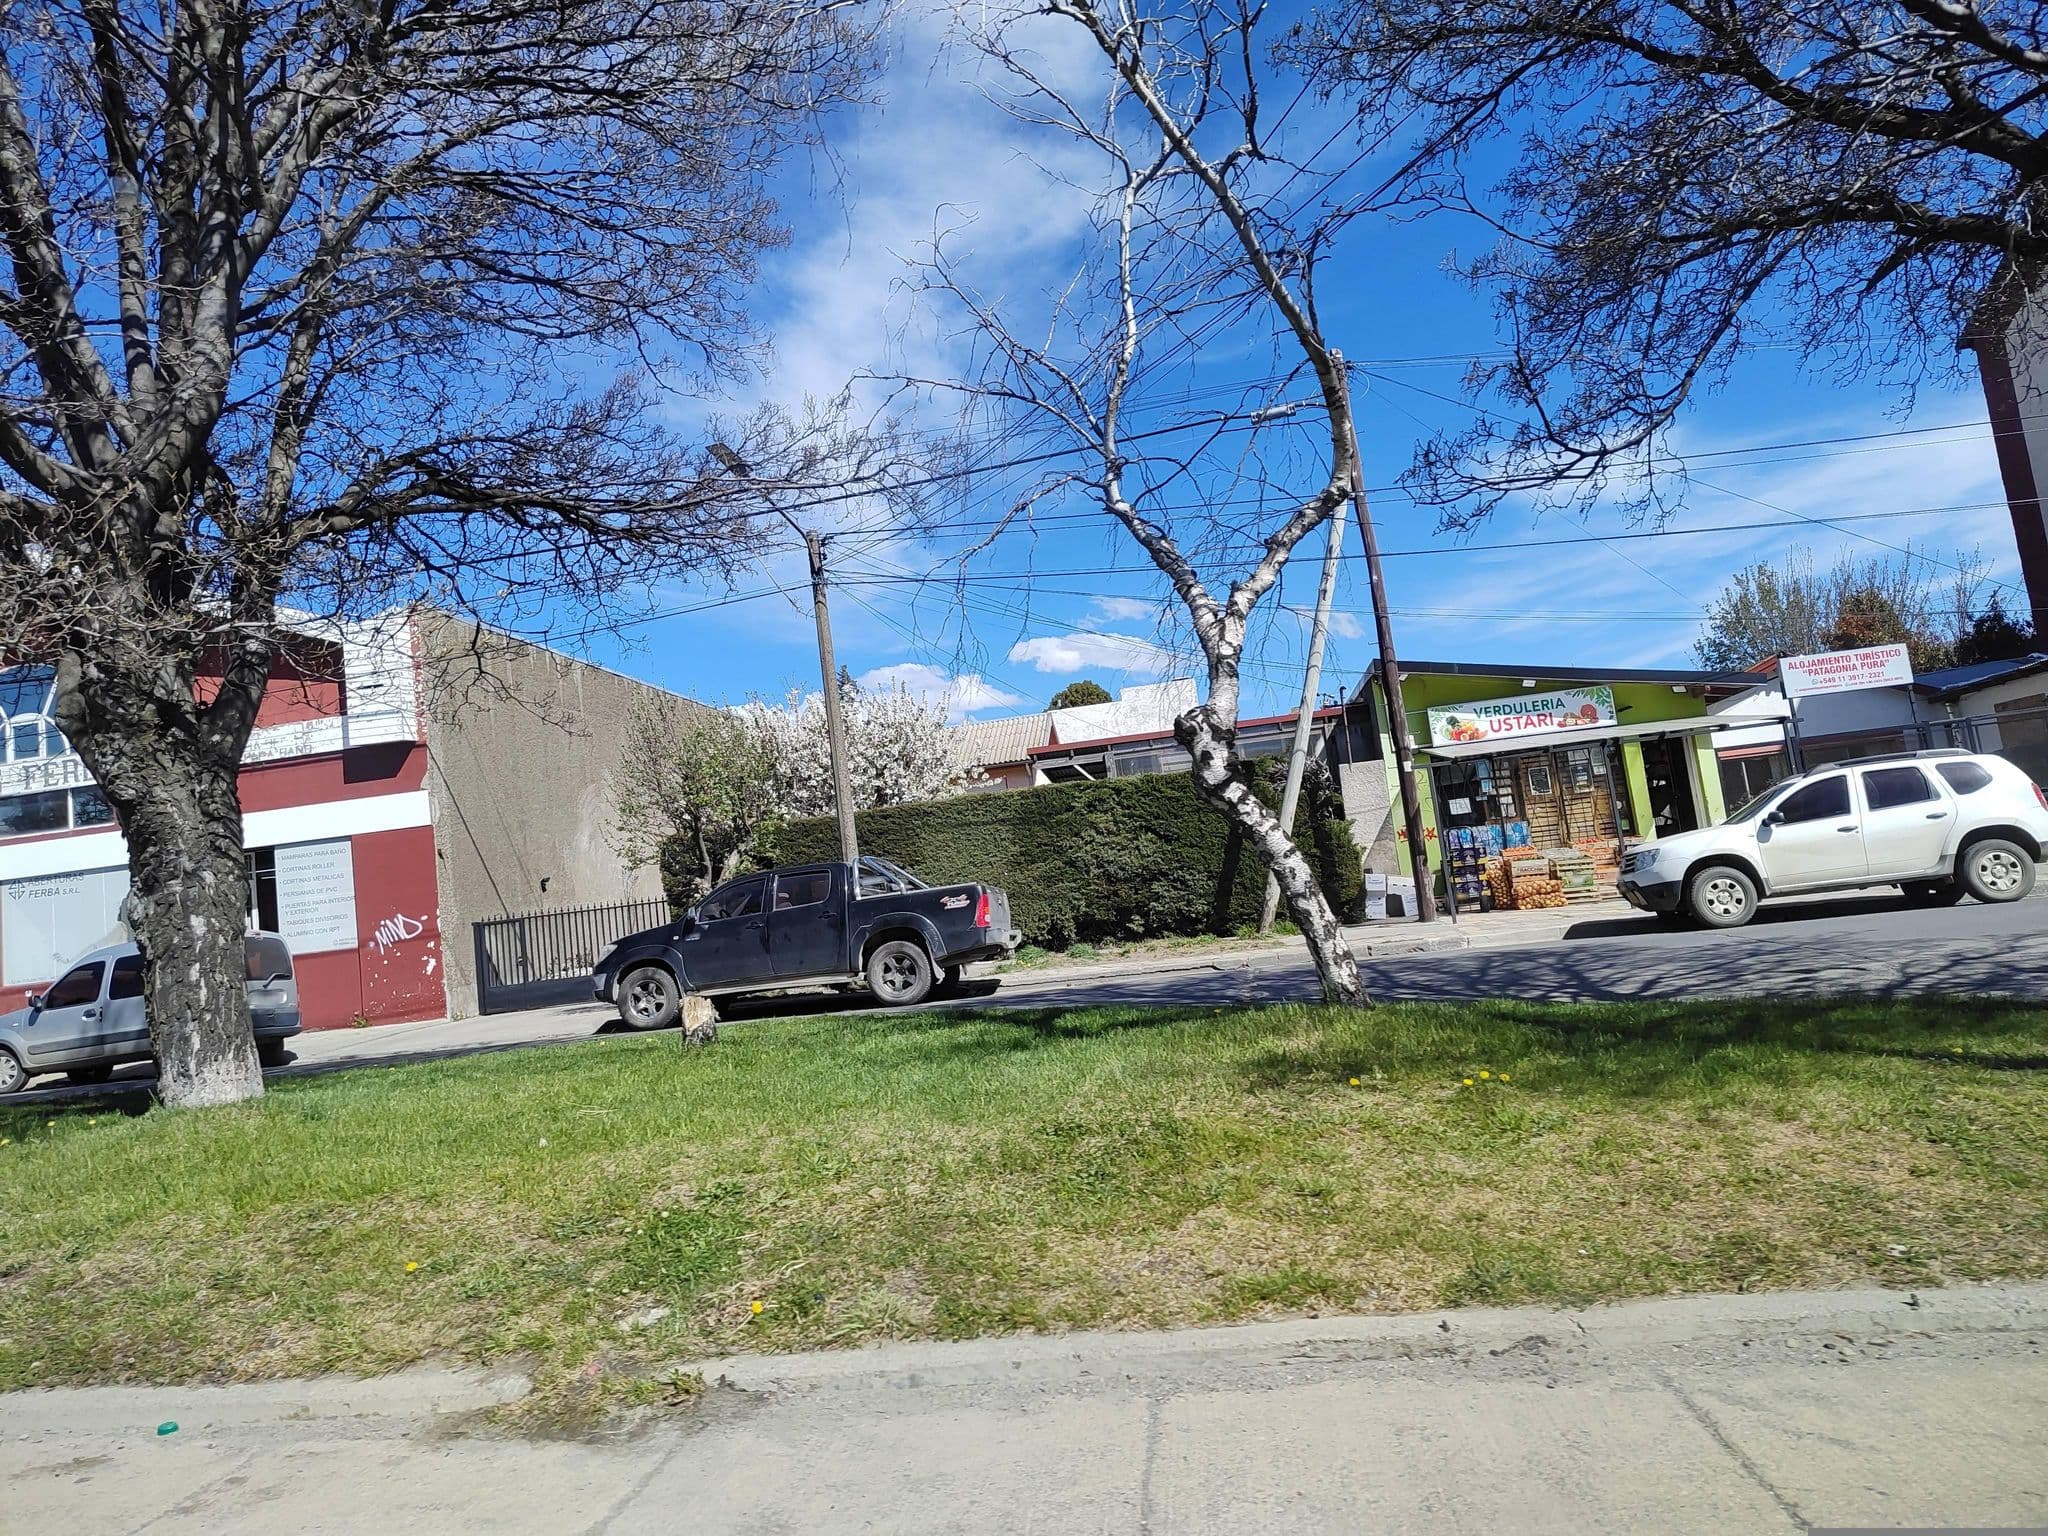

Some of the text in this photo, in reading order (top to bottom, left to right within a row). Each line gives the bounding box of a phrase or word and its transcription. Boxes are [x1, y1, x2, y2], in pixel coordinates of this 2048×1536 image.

[1788, 648, 1901, 671] ALOJAMIENTO TURÍSTICO
[1473, 697, 1566, 719] VERDULERIA
[1489, 712, 1554, 733] USTARI
[22, 759, 95, 790] FER
[281, 851, 313, 861] MAMPARAS
[314, 849, 330, 857] PARA
[282, 862, 335, 873] CORTINAS ROLLER
[27, 872, 85, 887] ABERTURAS
[282, 877, 312, 886] CORTINAS
[28, 887, 60, 899] FERBA
[283, 889, 315, 898] PERSIANAS
[285, 901, 311, 910] PUERTAS
[312, 899, 327, 907] PARA
[289, 907, 319, 916] EXTERIOR
